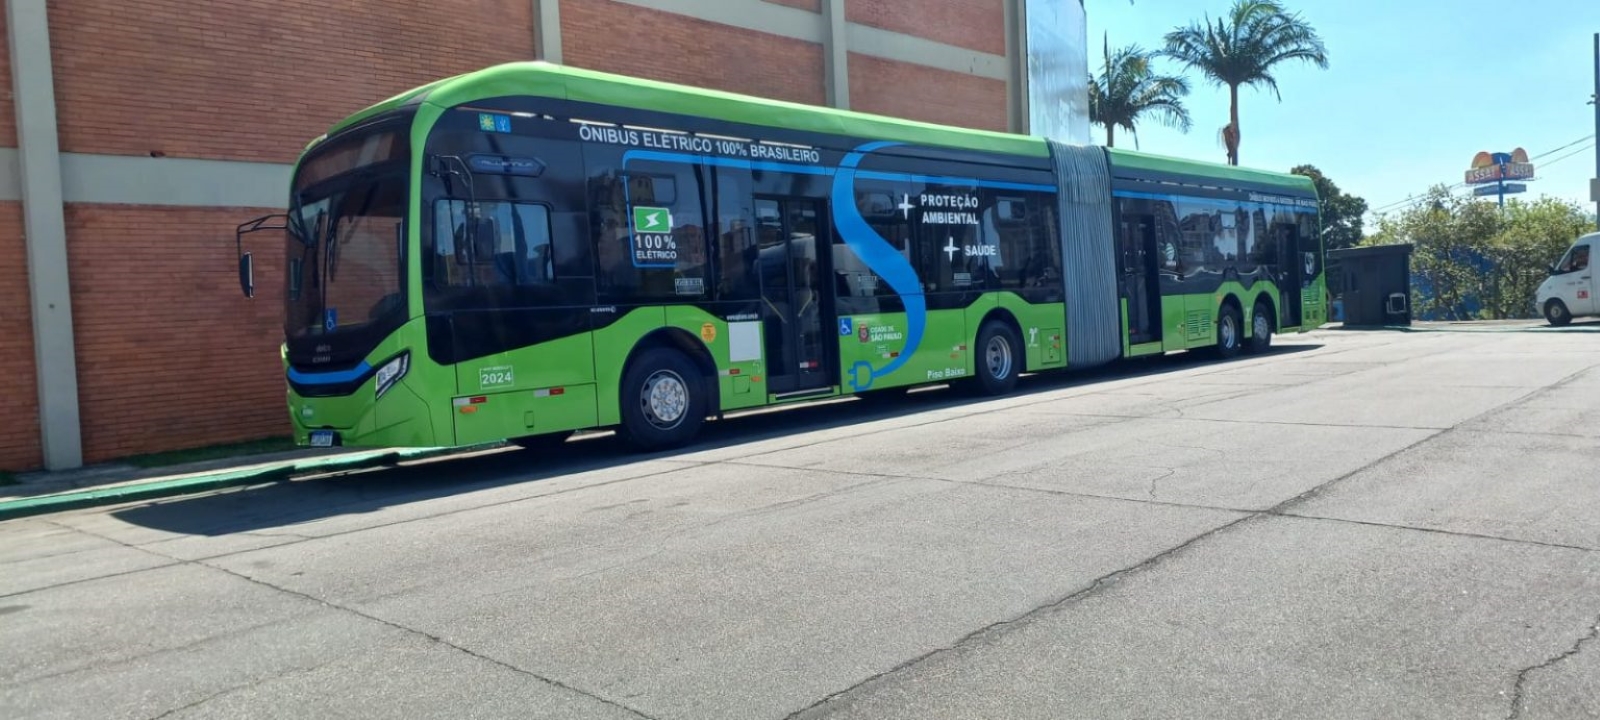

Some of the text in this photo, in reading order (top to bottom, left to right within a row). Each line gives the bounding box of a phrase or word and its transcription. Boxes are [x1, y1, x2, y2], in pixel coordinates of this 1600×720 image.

[580, 124, 820, 163] ÔNIBUS ELÉTRICO 100% BRASILEIRO
[920, 193, 979, 210] PROTEÇÃO
[922, 211, 979, 225] AMBIENTAL
[635, 234, 676, 250] 100%
[636, 249, 677, 259] ELÉTRICO
[964, 243, 997, 256] SAÚDE
[481, 371, 511, 385] 2024
[927, 367, 966, 379] Piso Baixo
